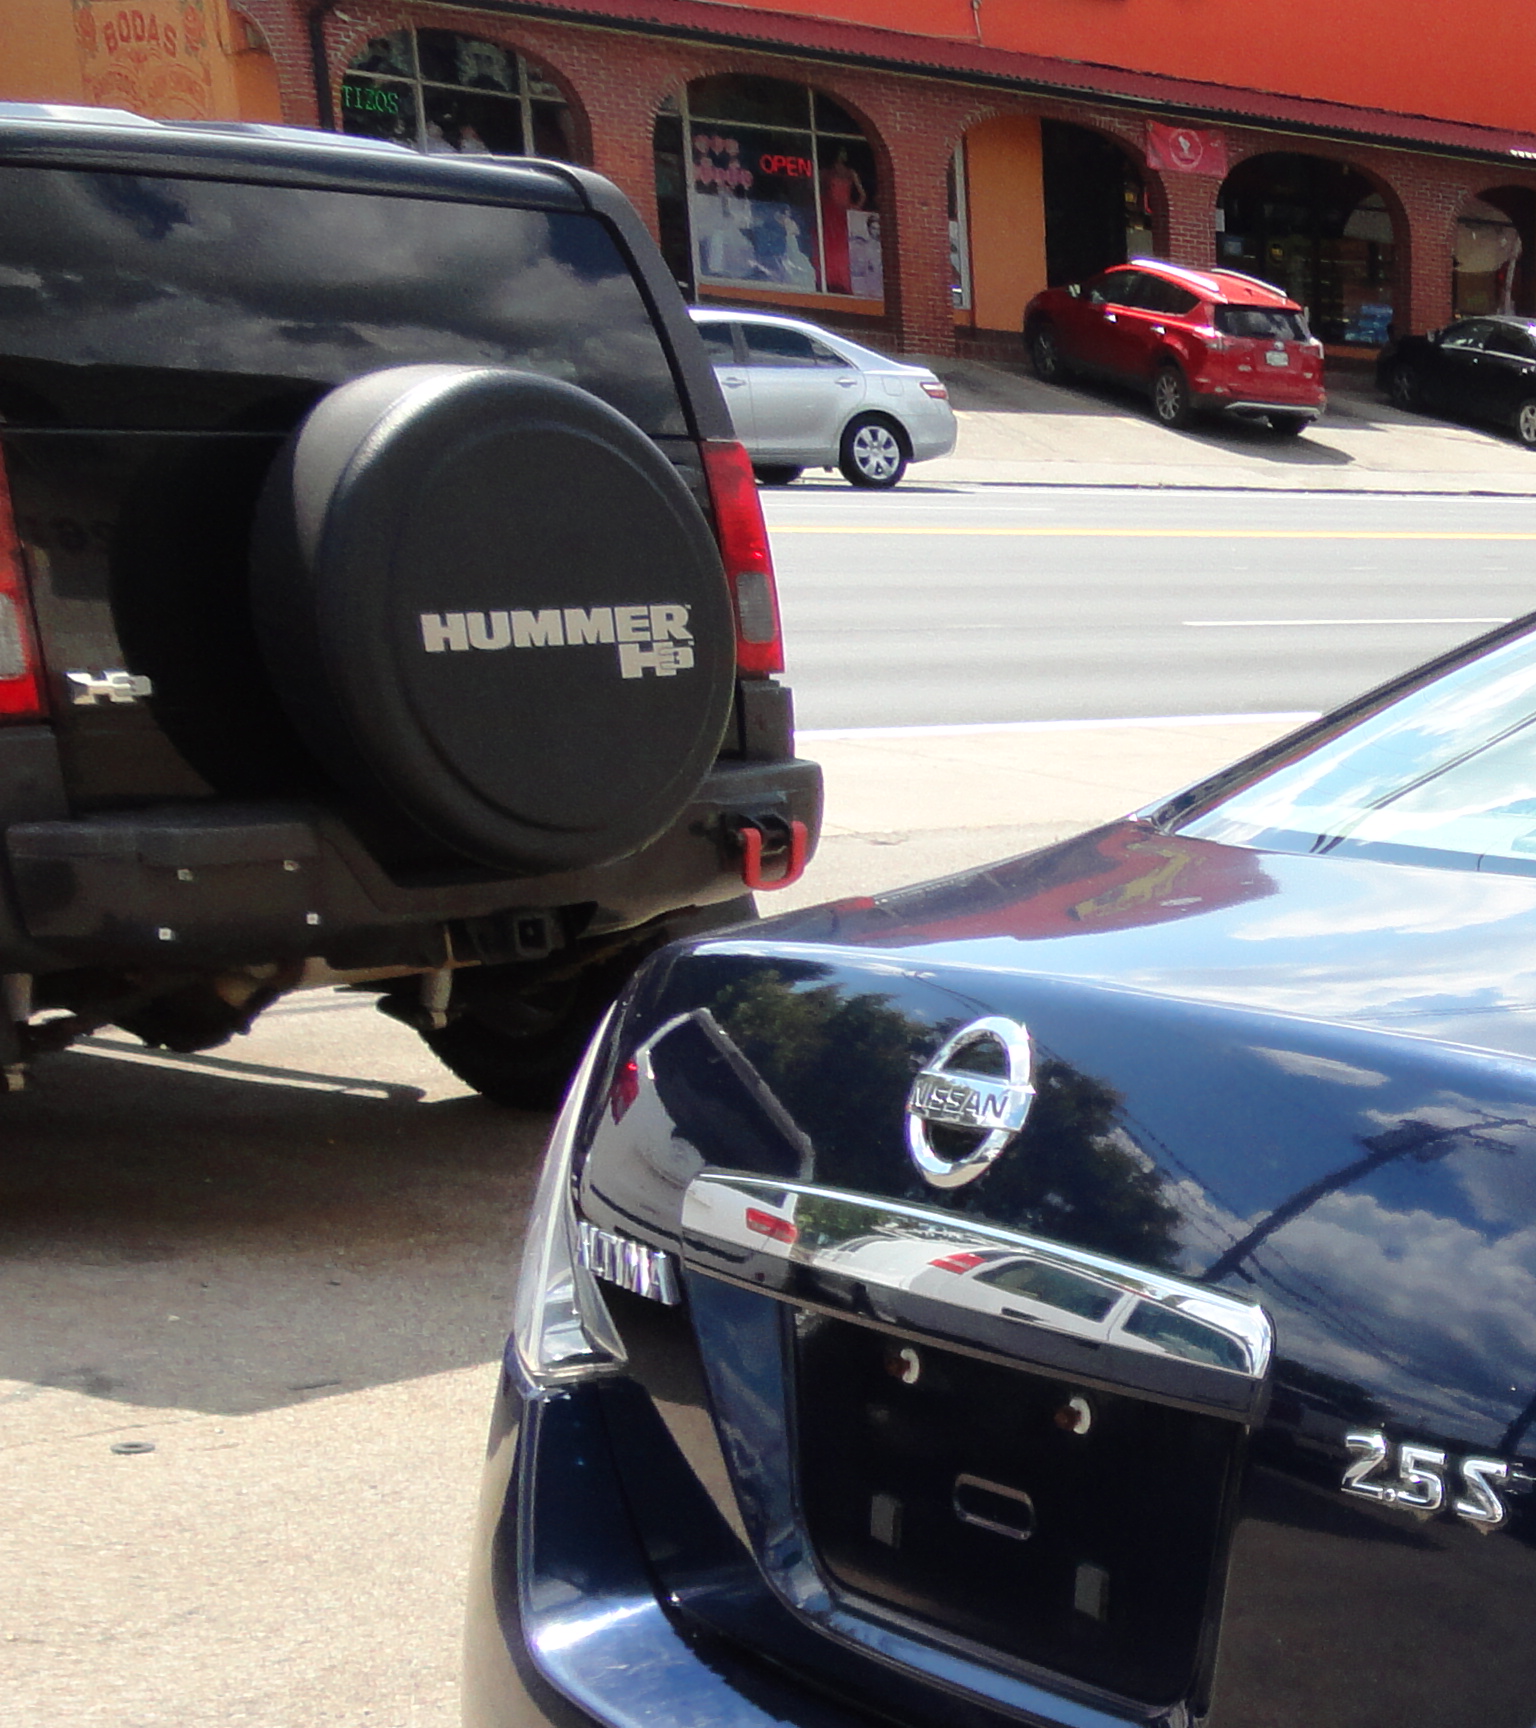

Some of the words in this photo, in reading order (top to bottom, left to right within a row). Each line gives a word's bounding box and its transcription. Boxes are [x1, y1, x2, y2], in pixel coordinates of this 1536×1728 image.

[103, 10, 177, 58] BODAS
[759, 154, 813, 177] OPEN
[420, 604, 693, 653] HUMMER
[619, 641, 694, 679] H3
[64, 671, 152, 705] H3
[909, 1080, 1009, 1119] NISSAN
